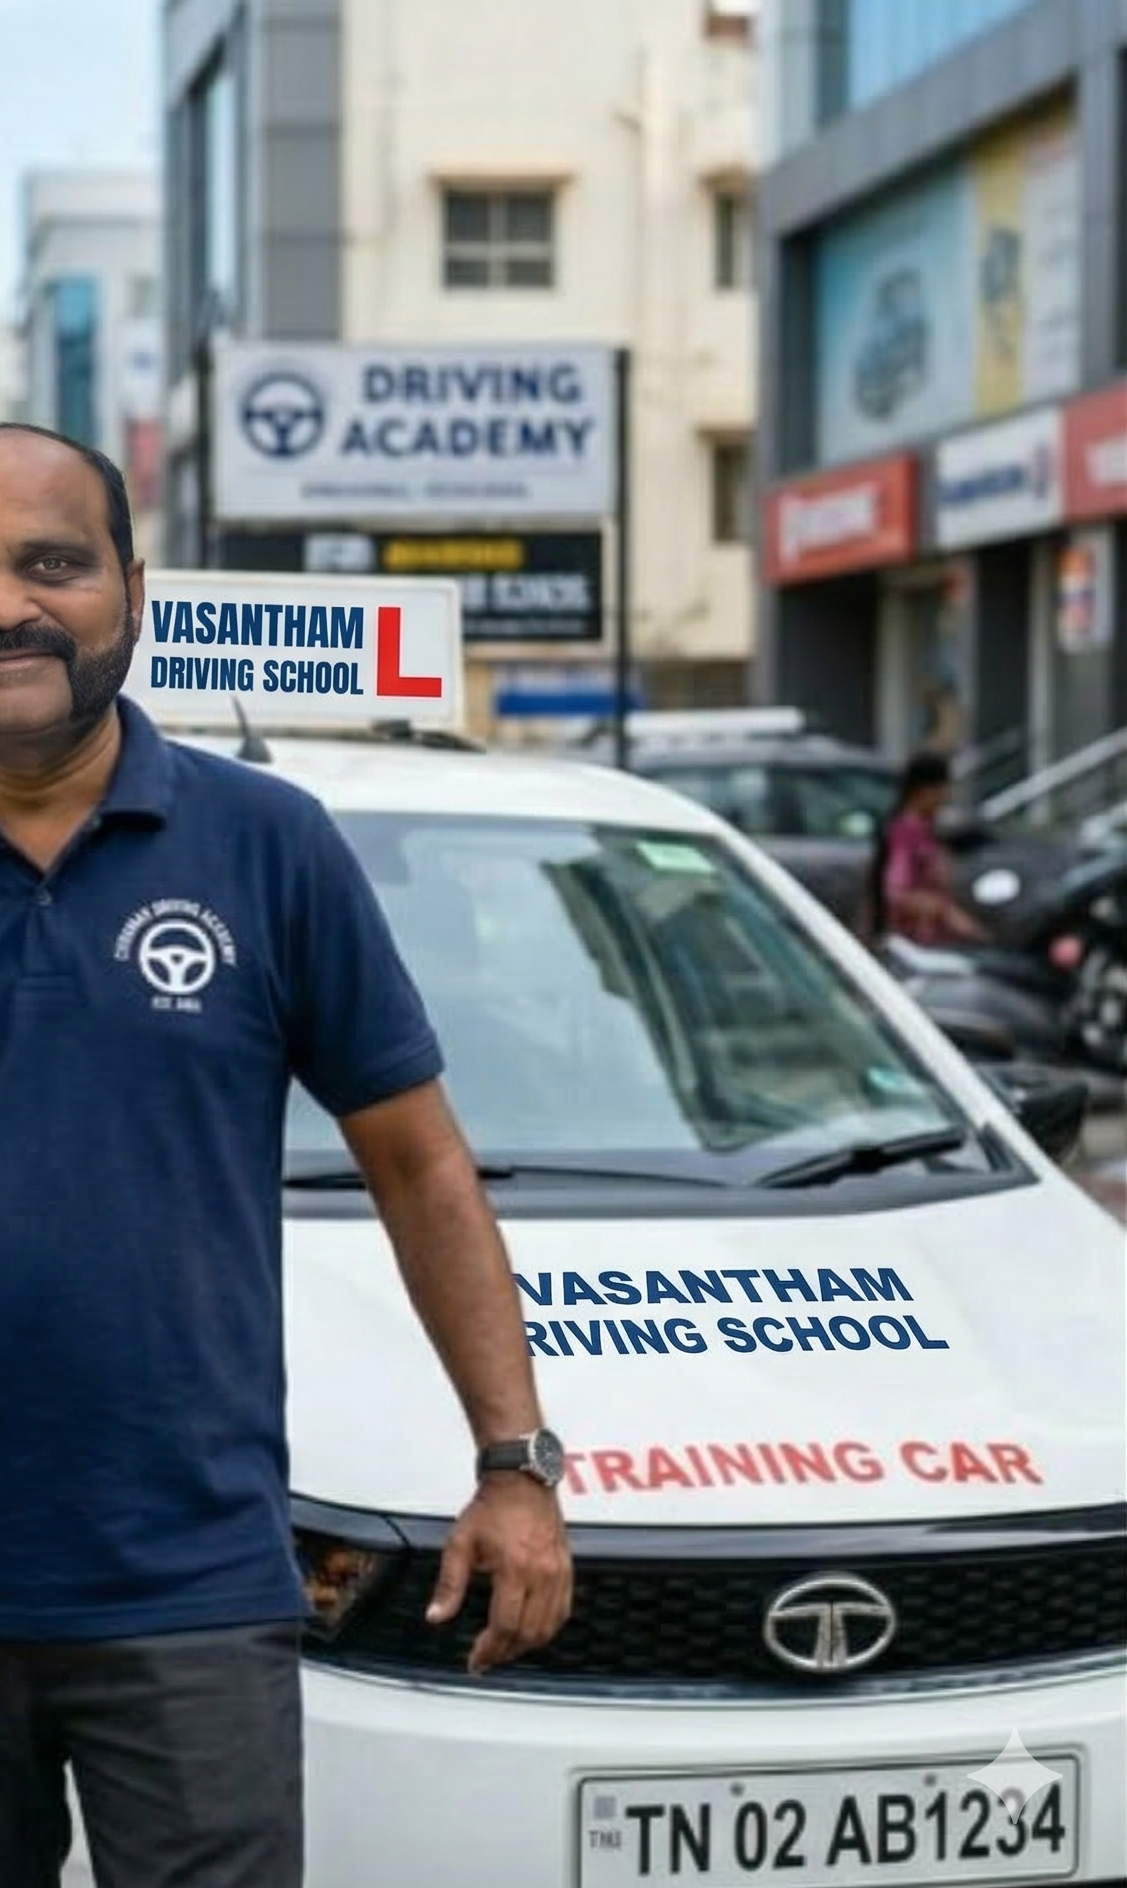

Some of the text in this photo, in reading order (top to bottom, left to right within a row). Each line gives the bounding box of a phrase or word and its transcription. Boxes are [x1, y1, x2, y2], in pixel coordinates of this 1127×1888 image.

[362, 364, 581, 404] DRIVING
[341, 417, 594, 459] ACADEMY
[151, 600, 364, 649] VASANTHAM
[377, 606, 443, 698] L
[151, 656, 364, 695] DRIVING SCHOOL
[511, 1267, 915, 1307] VASANTHAM
[523, 1315, 950, 1357] RIVING SCHOOL
[561, 1441, 1046, 1496] TRAINING CAR
[625, 1803, 711, 1875] TN
[734, 1798, 807, 1871] 02
